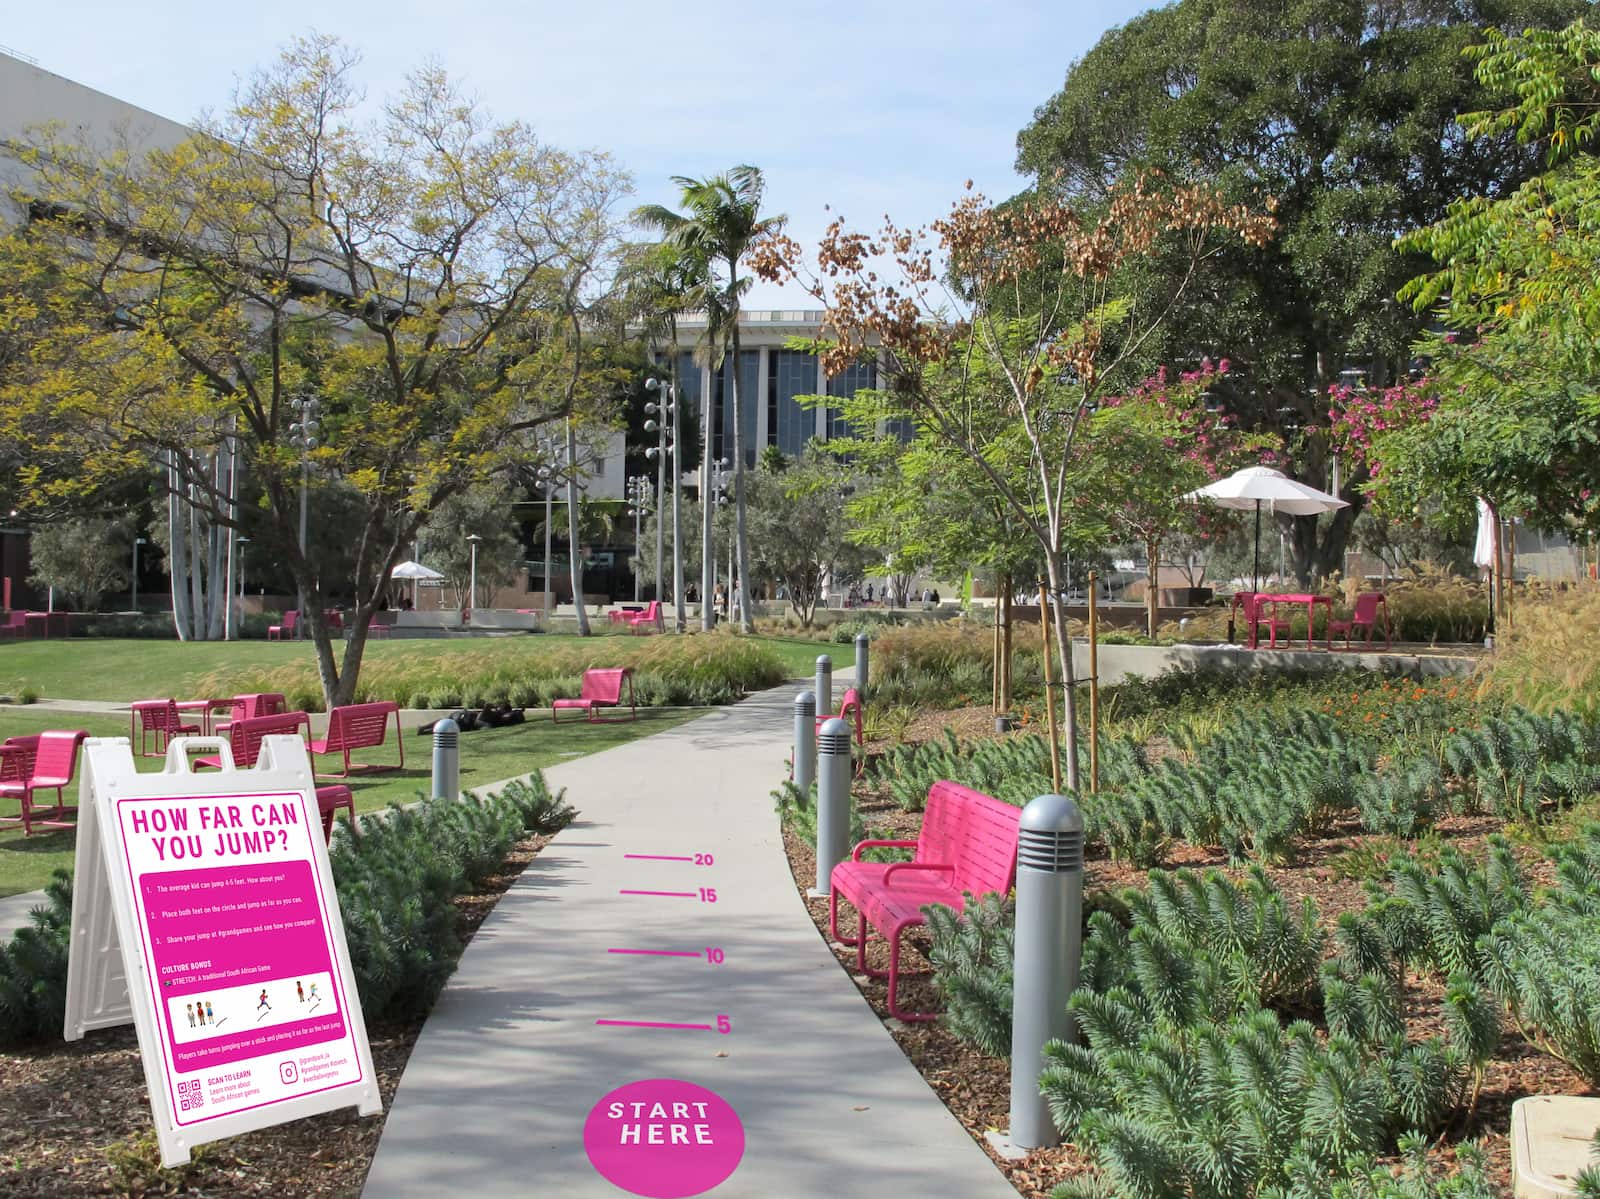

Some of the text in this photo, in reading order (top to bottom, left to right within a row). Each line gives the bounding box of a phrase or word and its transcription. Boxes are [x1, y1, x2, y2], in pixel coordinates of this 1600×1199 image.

[131, 803, 298, 833] HOW FAR CAN
[152, 830, 288, 861] YOU JUMP?
[695, 854, 714, 866] 20
[699, 887, 717, 902] 15
[705, 947, 725, 964] 10
[716, 1016, 732, 1034] 5
[607, 1102, 709, 1119] START
[620, 1123, 714, 1144] HERE
